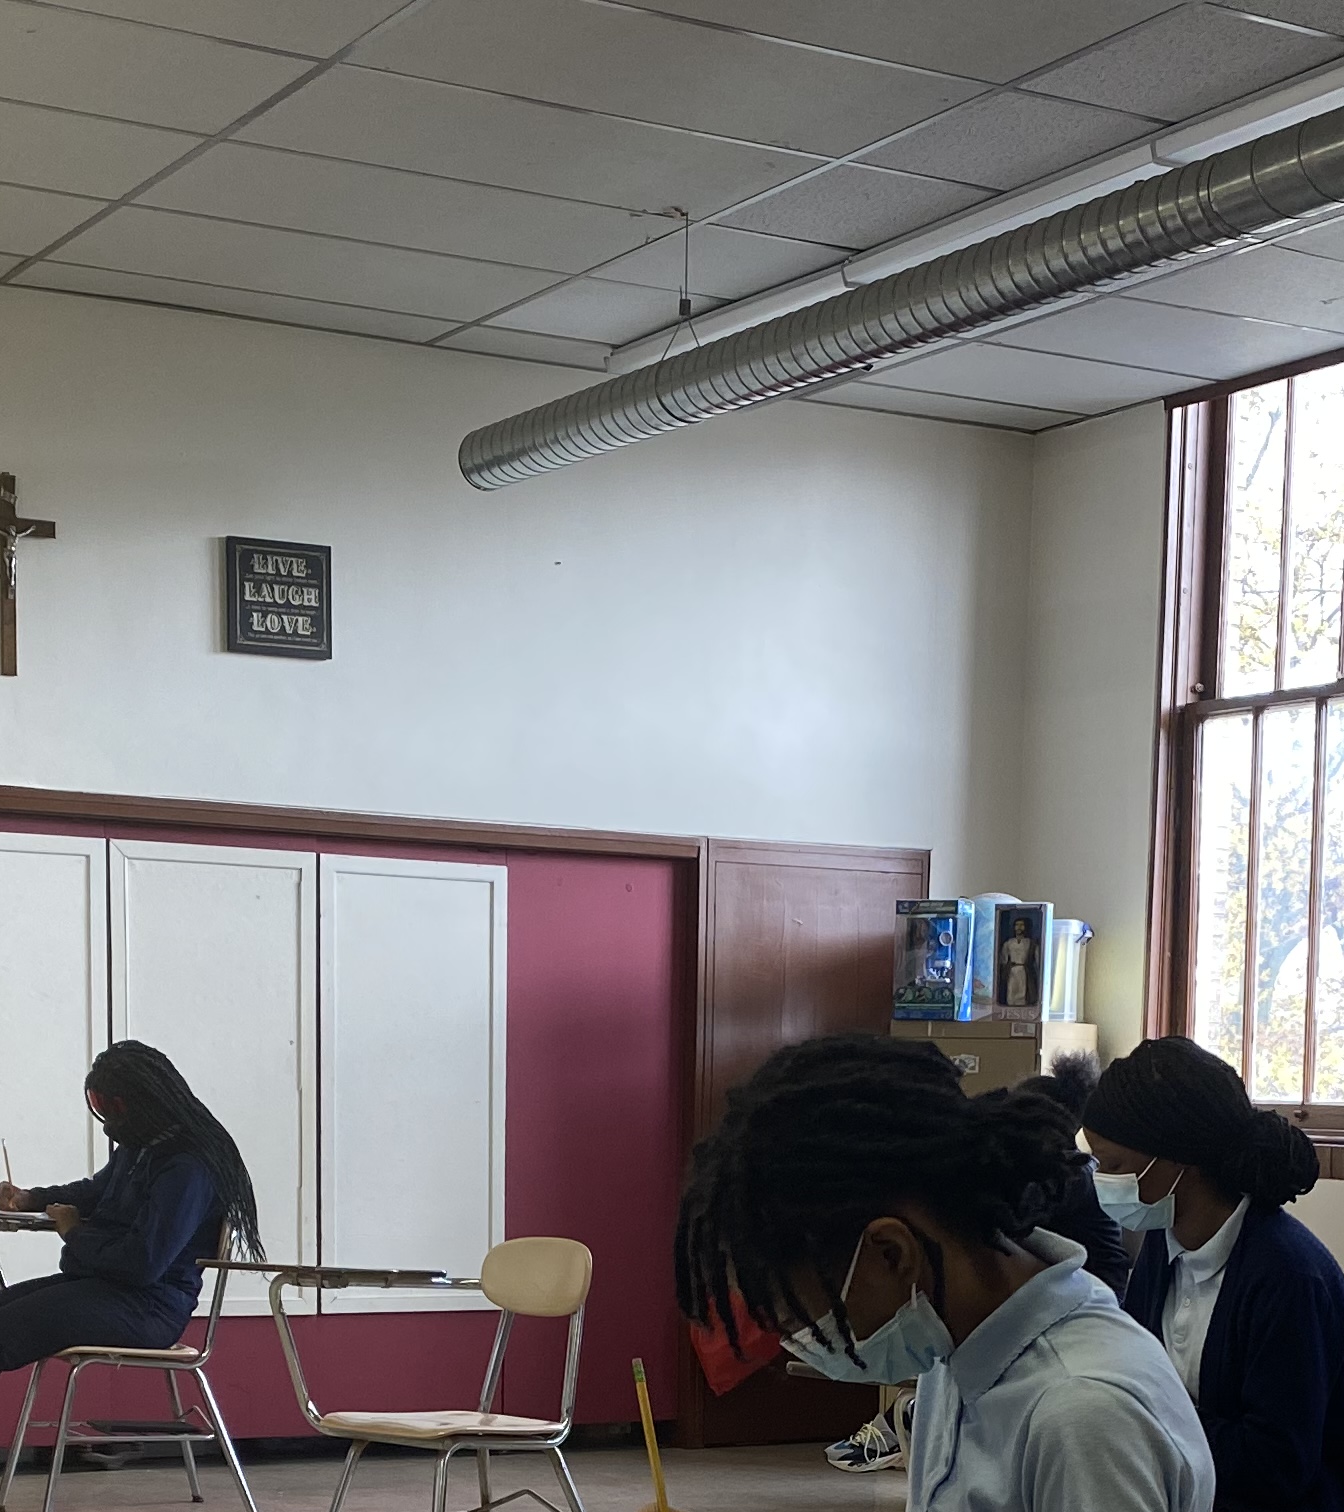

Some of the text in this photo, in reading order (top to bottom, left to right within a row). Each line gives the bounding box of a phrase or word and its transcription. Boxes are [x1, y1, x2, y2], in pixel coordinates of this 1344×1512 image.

[252, 554, 307, 577] LIVE
[244, 581, 319, 607] LAUGH
[251, 612, 312, 635] LOVE
[998, 1009, 1036, 1020] JESUS
